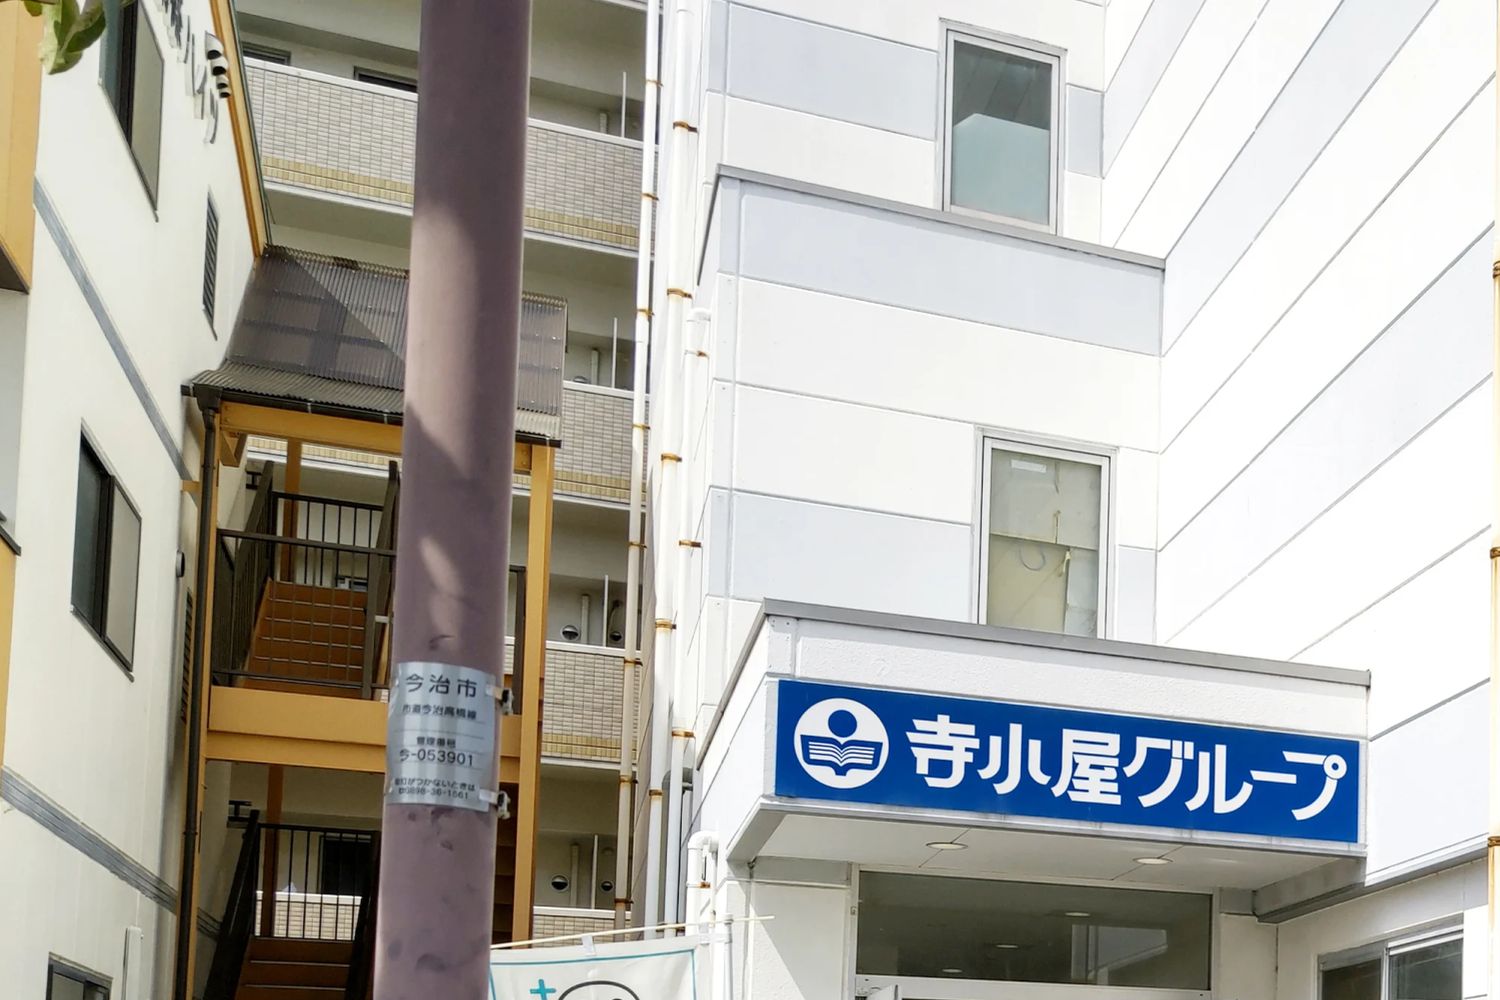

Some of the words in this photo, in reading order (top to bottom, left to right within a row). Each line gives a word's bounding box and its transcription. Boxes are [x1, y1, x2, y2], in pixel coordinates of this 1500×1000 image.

[406, 673, 477, 698] 今治市
[905, 713, 1347, 821] 寺小屋グループ
